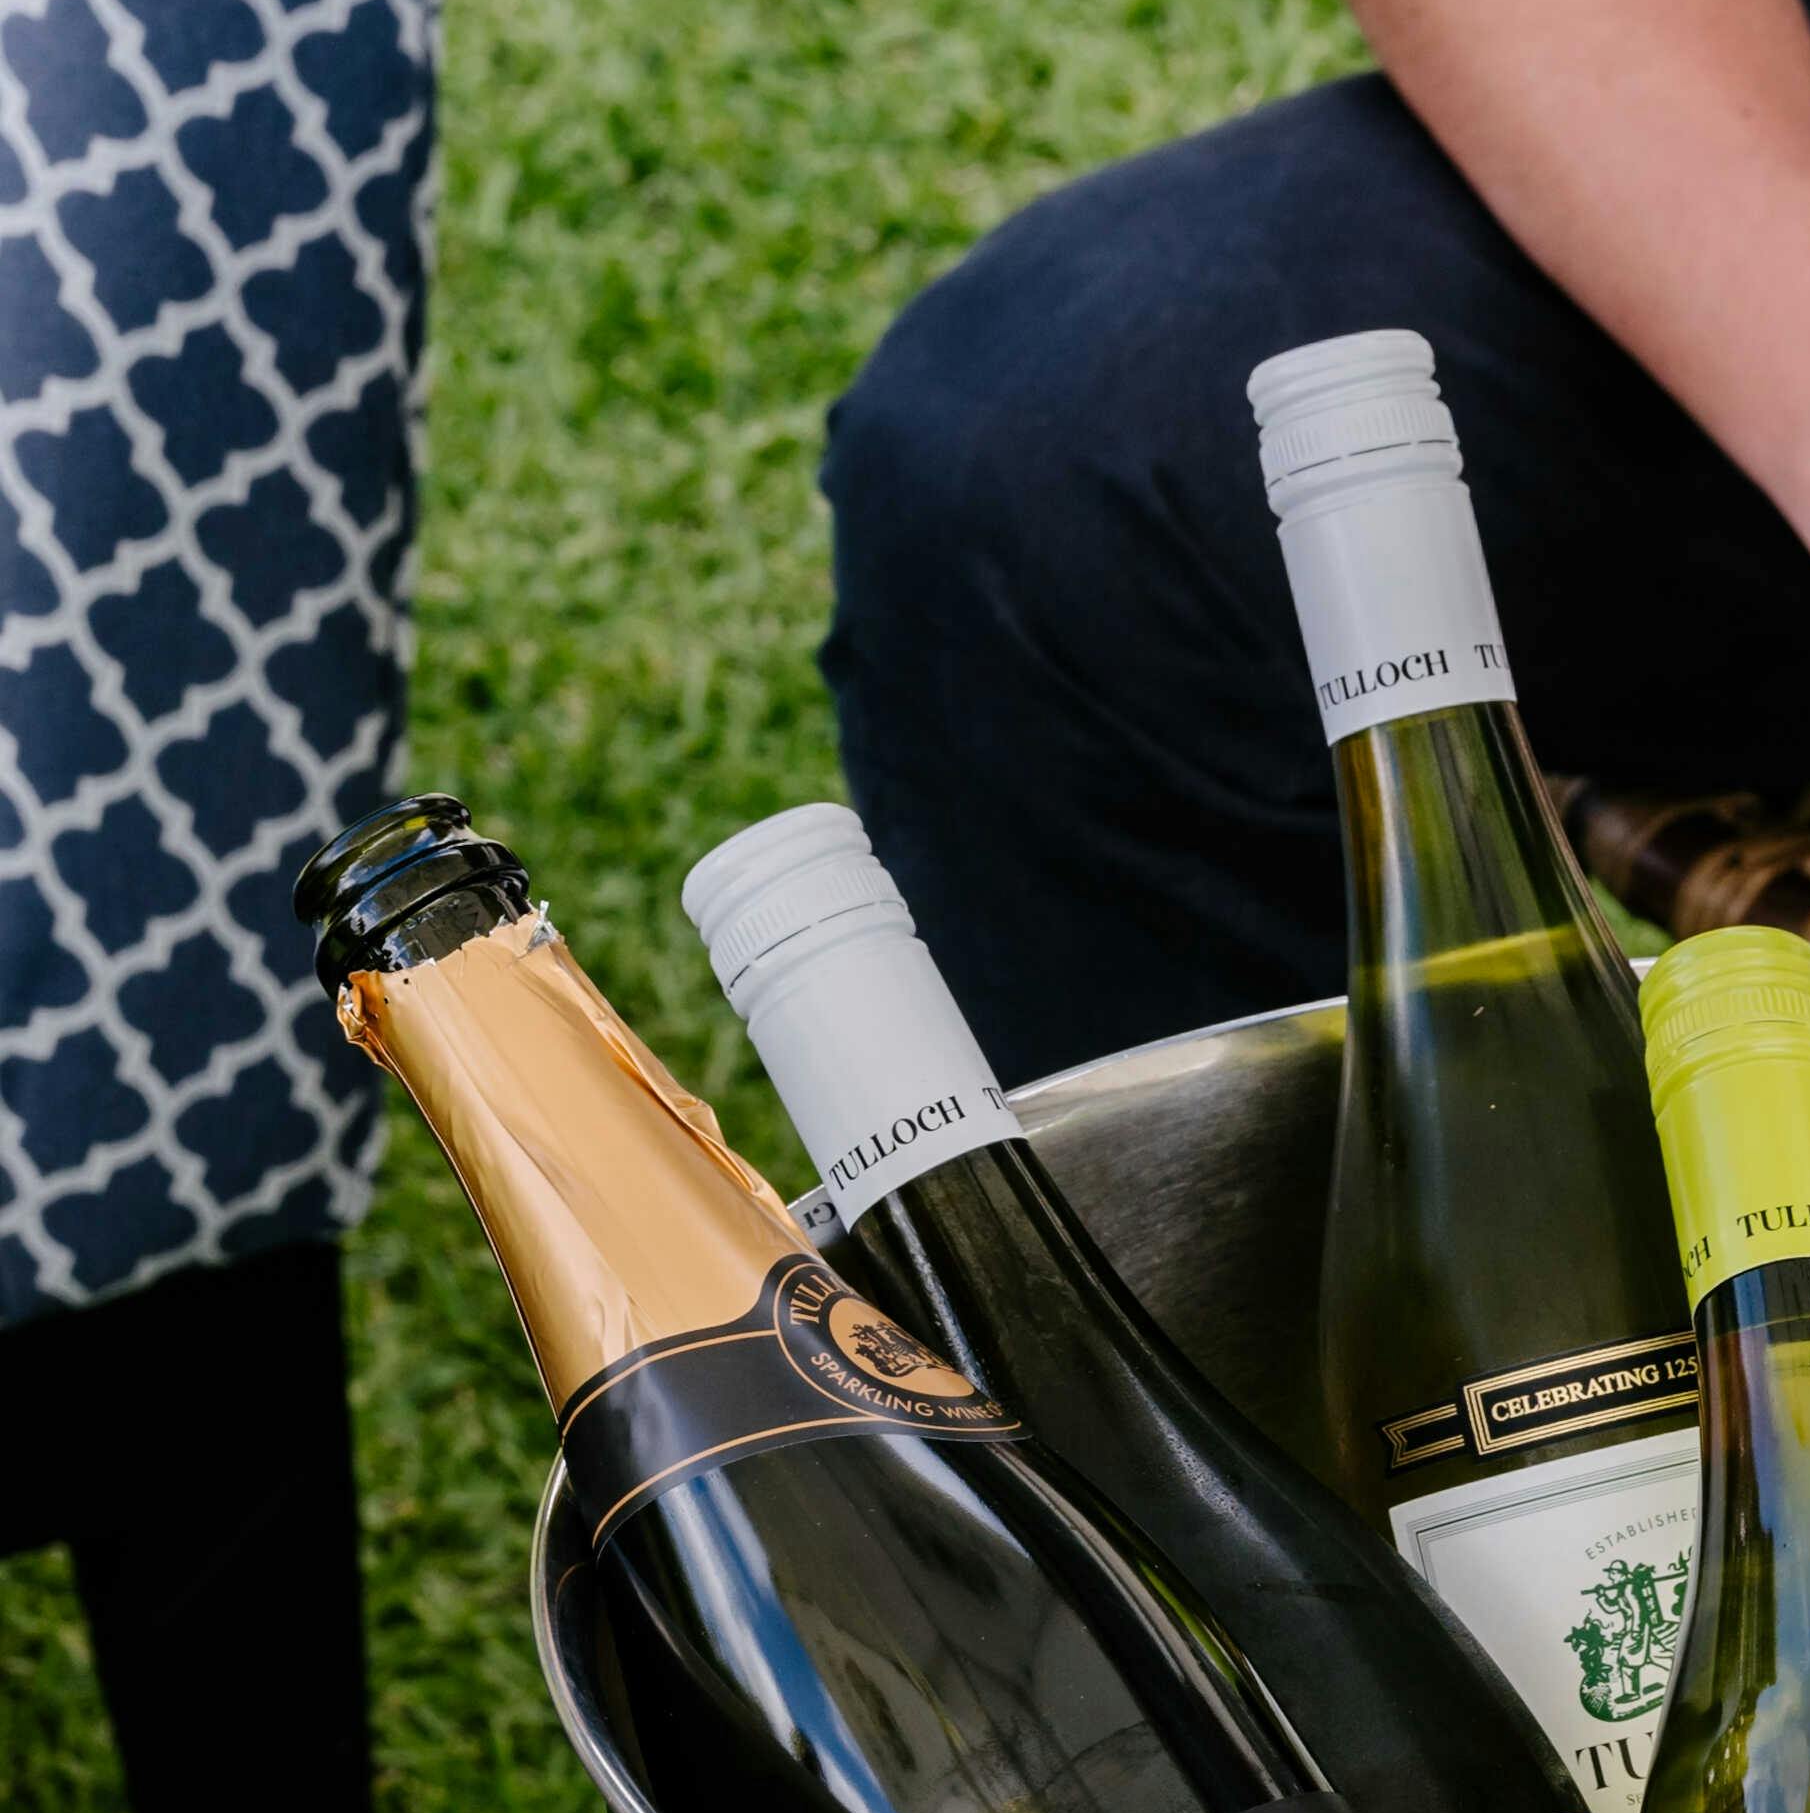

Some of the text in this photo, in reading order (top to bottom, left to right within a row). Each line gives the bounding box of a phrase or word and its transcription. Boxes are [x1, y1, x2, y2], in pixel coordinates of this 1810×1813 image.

[1319, 649, 1450, 711] TULLOCH
[828, 1094, 967, 1192] TULLOCH
[1682, 1236, 1712, 1280] CH
[810, 1351, 935, 1418] SPARKLING
[1491, 1356, 1698, 1424] CELEBRATING 125
